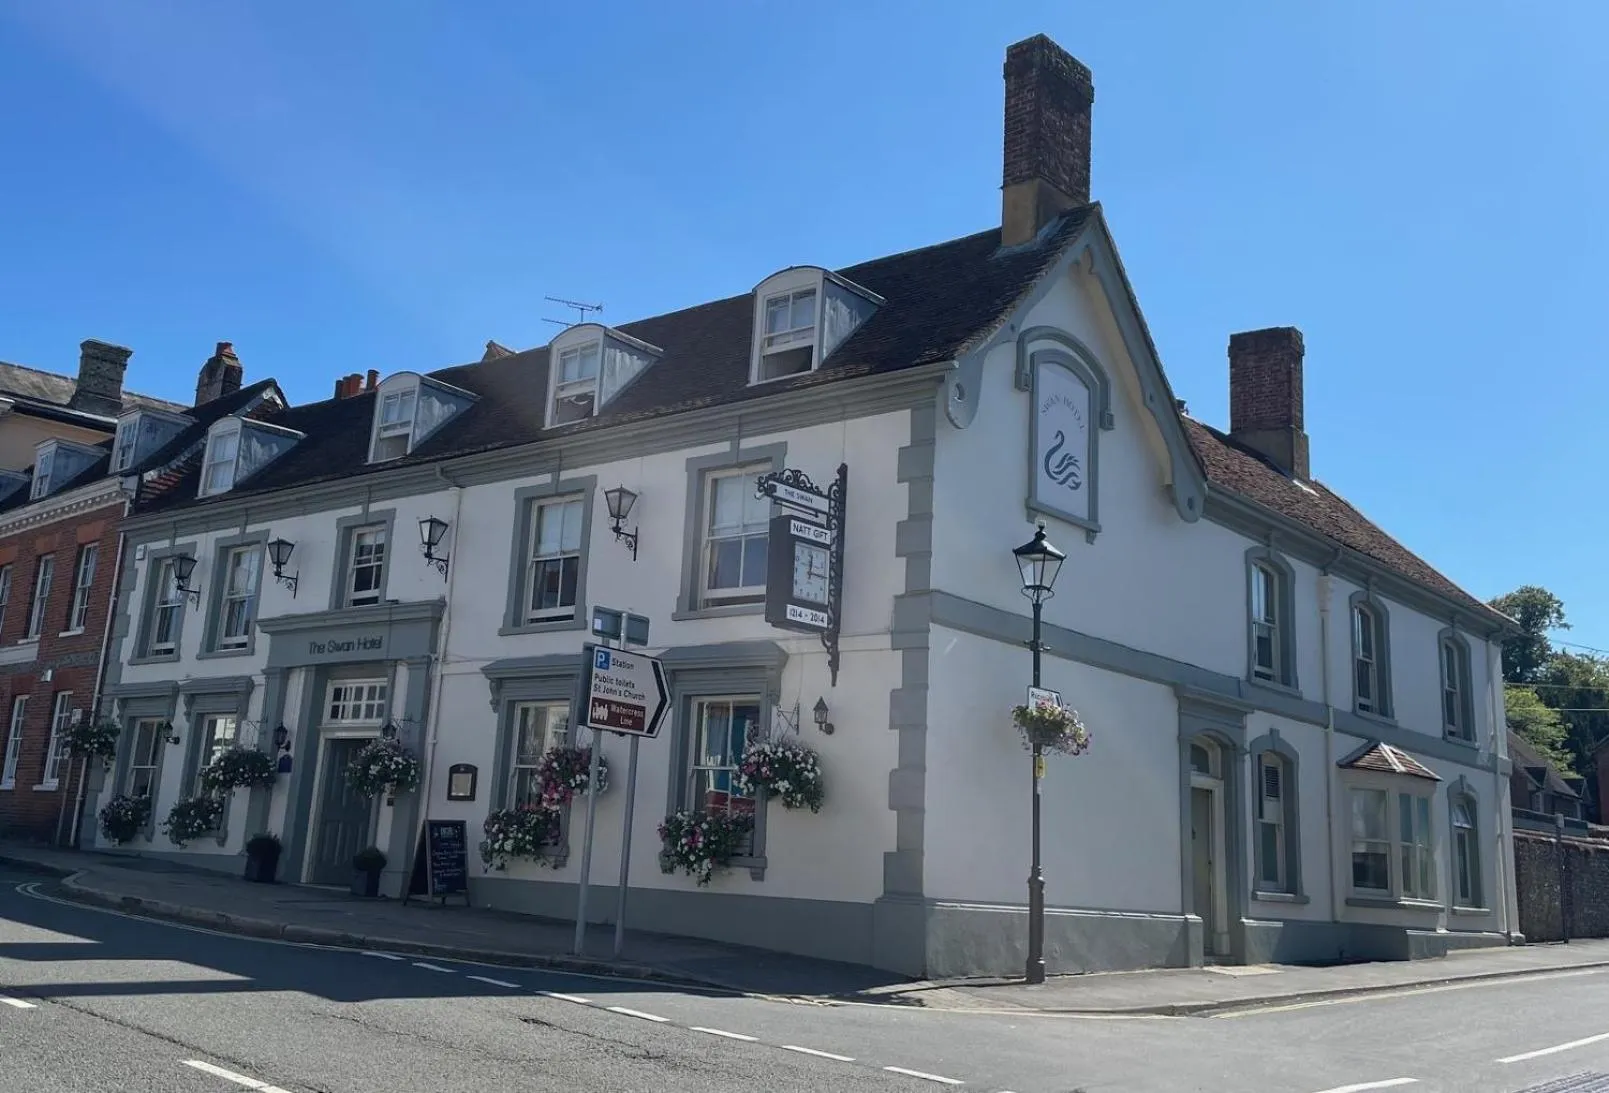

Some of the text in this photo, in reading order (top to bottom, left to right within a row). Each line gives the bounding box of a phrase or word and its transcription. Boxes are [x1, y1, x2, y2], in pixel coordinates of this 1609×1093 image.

[785, 489, 813, 504] THE SWAN
[793, 523, 828, 540] NATT GIFT
[810, 611, 825, 624] 2014
[309, 636, 383, 654] The Swan Hotel
[612, 658, 634, 669] Station
[594, 673, 635, 688] Public toilets
[593, 684, 645, 700] St John's Church
[611, 704, 644, 717] Watercress
[620, 716, 633, 725] Line
